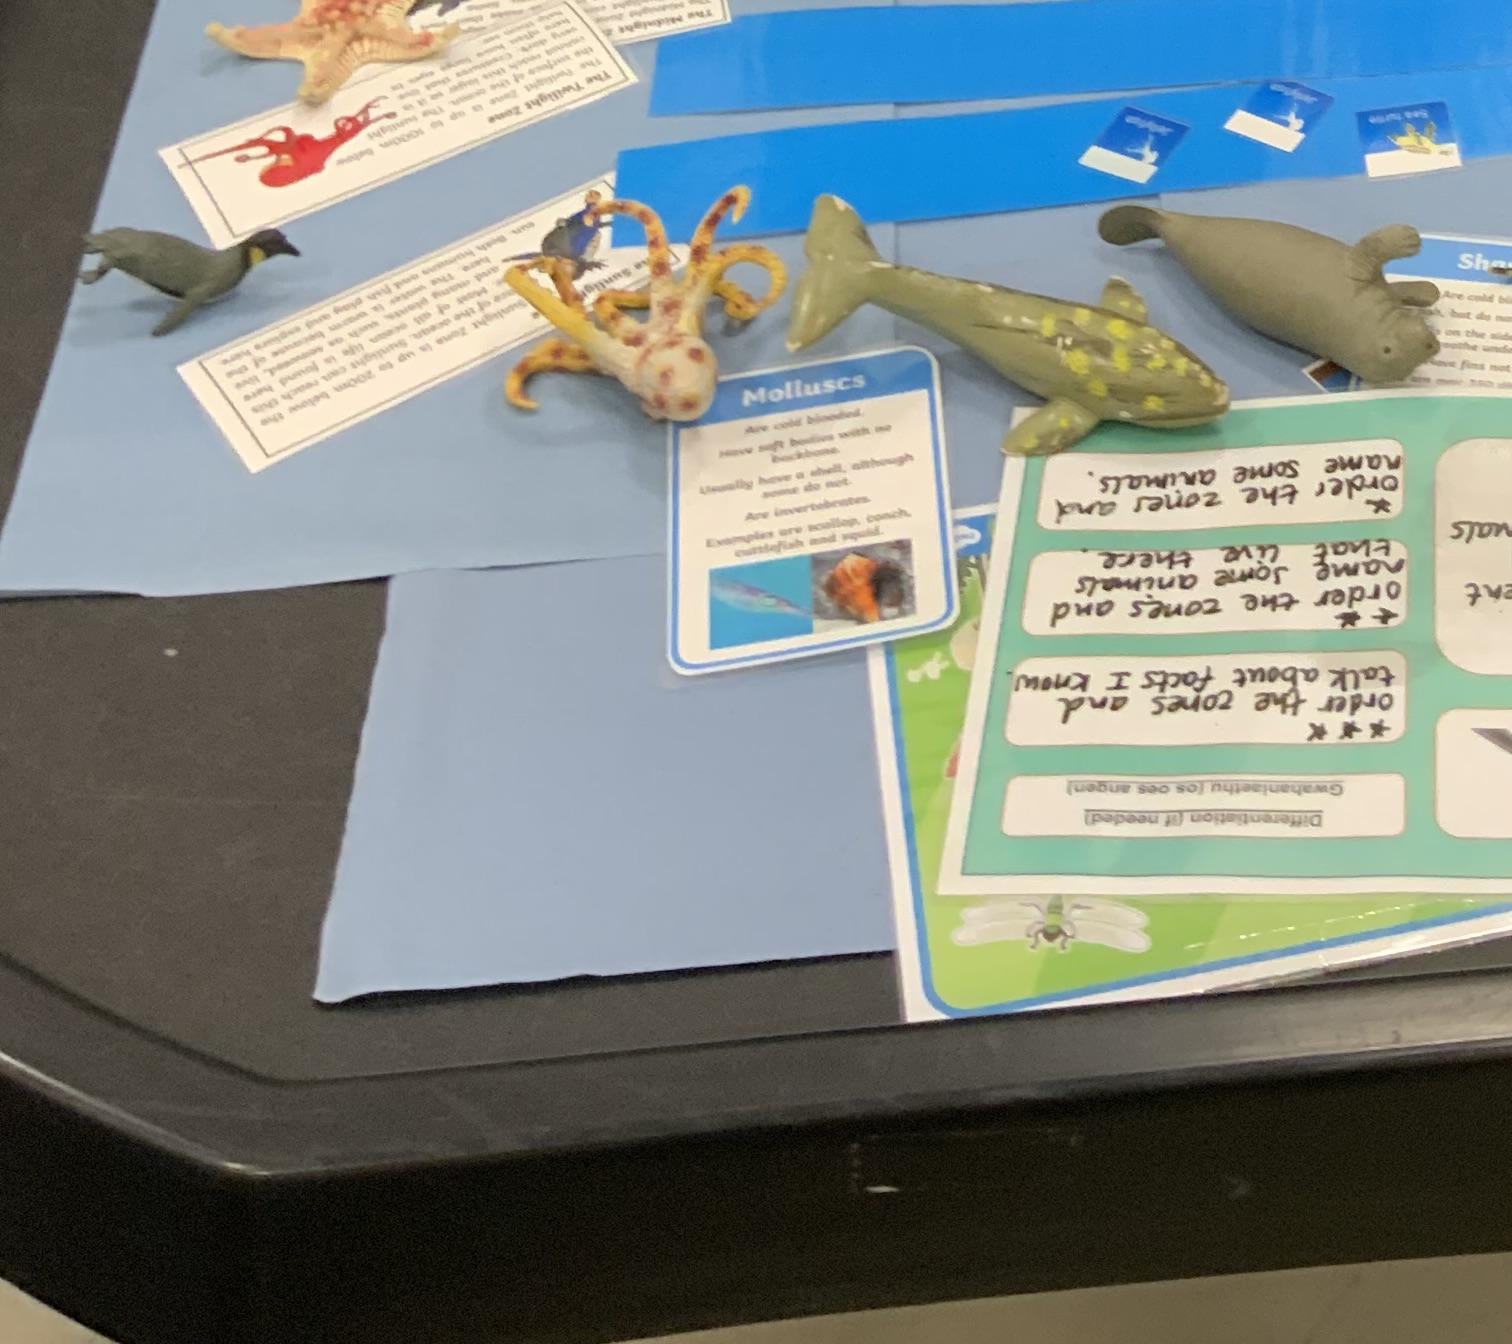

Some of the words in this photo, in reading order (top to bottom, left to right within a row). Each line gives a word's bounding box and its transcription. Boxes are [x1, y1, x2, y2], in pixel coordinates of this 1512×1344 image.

[585, 69, 611, 86] The
[524, 78, 583, 111] Twilight
[487, 105, 522, 126] Zone
[1443, 290, 1464, 301] Are
[1467, 293, 1495, 304] cold
[1450, 309, 1471, 320] but
[1476, 311, 1492, 322] do
[435, 326, 467, 347] Zone
[1445, 329, 1461, 337] on
[1465, 328, 1486, 340] the
[378, 360, 392, 373] to
[396, 349, 414, 363] up
[332, 369, 374, 395] 200m
[741, 373, 866, 407] Molluscs
[288, 390, 328, 416] below
[260, 411, 283, 428] the
[699, 477, 753, 496] Usually
[758, 472, 791, 485] have
[851, 453, 914, 472] although
[1232, 459, 1298, 479] some
[1323, 454, 1401, 474] name
[1240, 484, 1297, 505] the
[1314, 473, 1398, 498] order
[1054, 497, 1116, 523] and
[1132, 490, 1220, 511] zones
[705, 528, 773, 548] Examples
[779, 525, 802, 535] are
[1218, 543, 1278, 561] live
[1311, 538, 1390, 559] that
[1213, 563, 1288, 587] some
[1312, 557, 1403, 581] name
[1075, 572, 1197, 598] animals
[1312, 580, 1400, 609] order
[1048, 599, 1114, 627] and
[1127, 596, 1221, 617] zones
[1239, 592, 1299, 613] the
[1140, 664, 1212, 691] facts
[1232, 664, 1318, 690] about
[1326, 664, 1393, 690] talk
[1055, 695, 1128, 723] and
[1150, 688, 1232, 717] zones
[1252, 688, 1305, 717] the
[1317, 691, 1392, 716] order
[1137, 781, 1169, 796] oes
[1210, 780, 1343, 796] Gwahaniaethu
[1083, 809, 1158, 826] needed)
[1189, 810, 1322, 827] Differentiation
